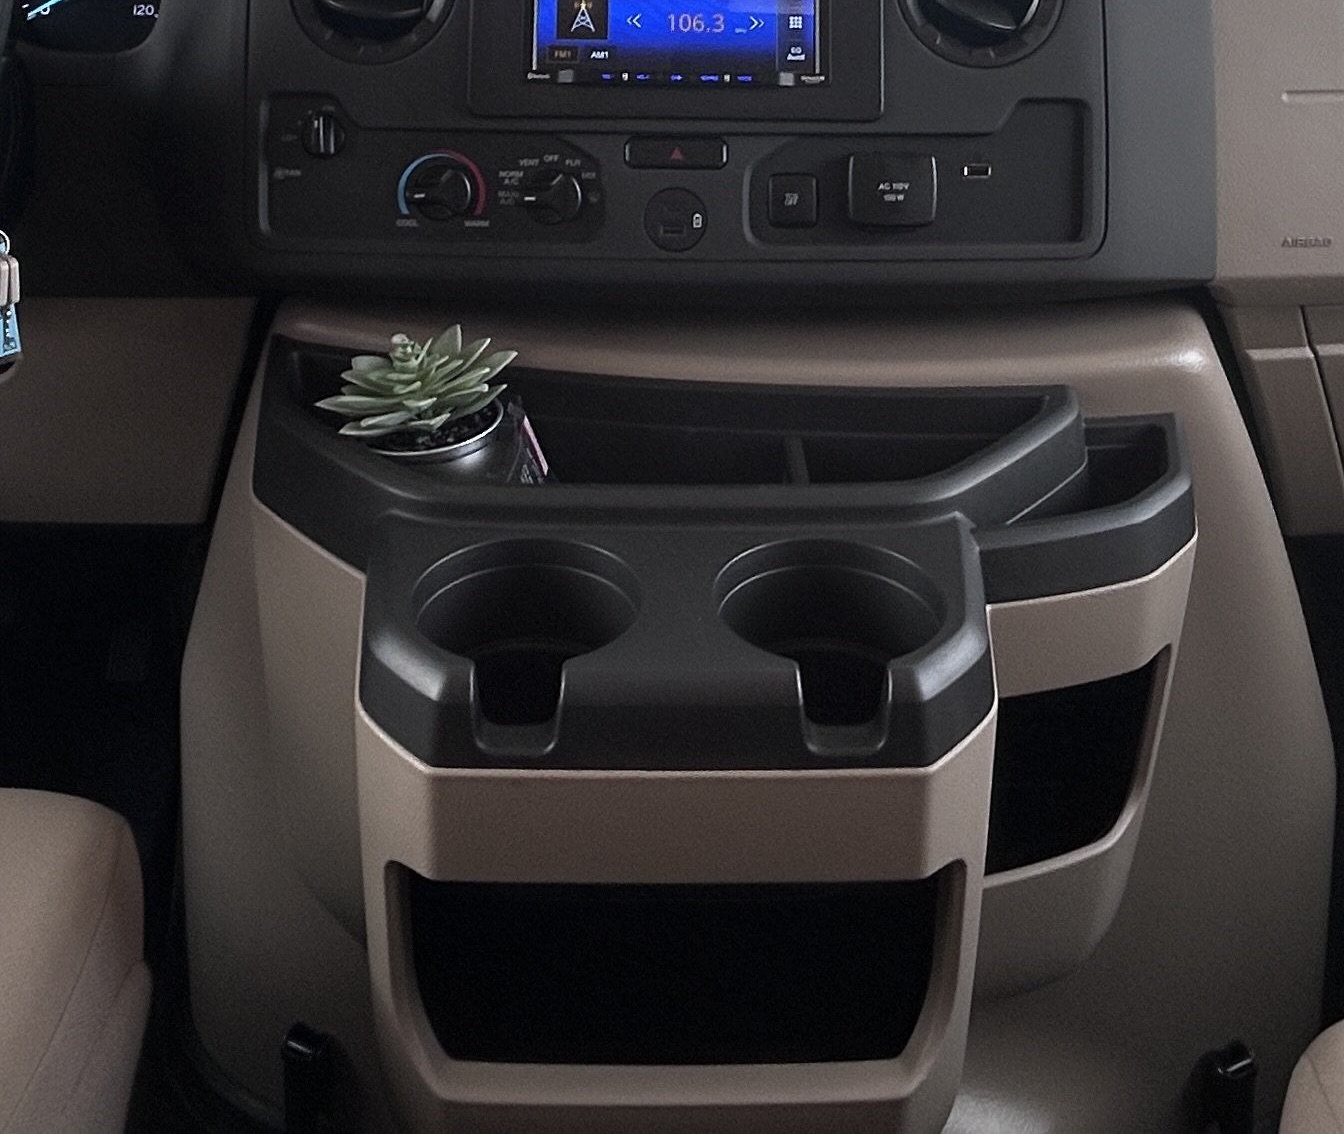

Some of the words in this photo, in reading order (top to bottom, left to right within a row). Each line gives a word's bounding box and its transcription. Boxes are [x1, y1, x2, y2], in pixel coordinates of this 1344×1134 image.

[132, 4, 155, 16] 120
[667, 12, 725, 33] 106.3
[590, 50, 609, 59] AM1
[543, 154, 560, 163] OFF
